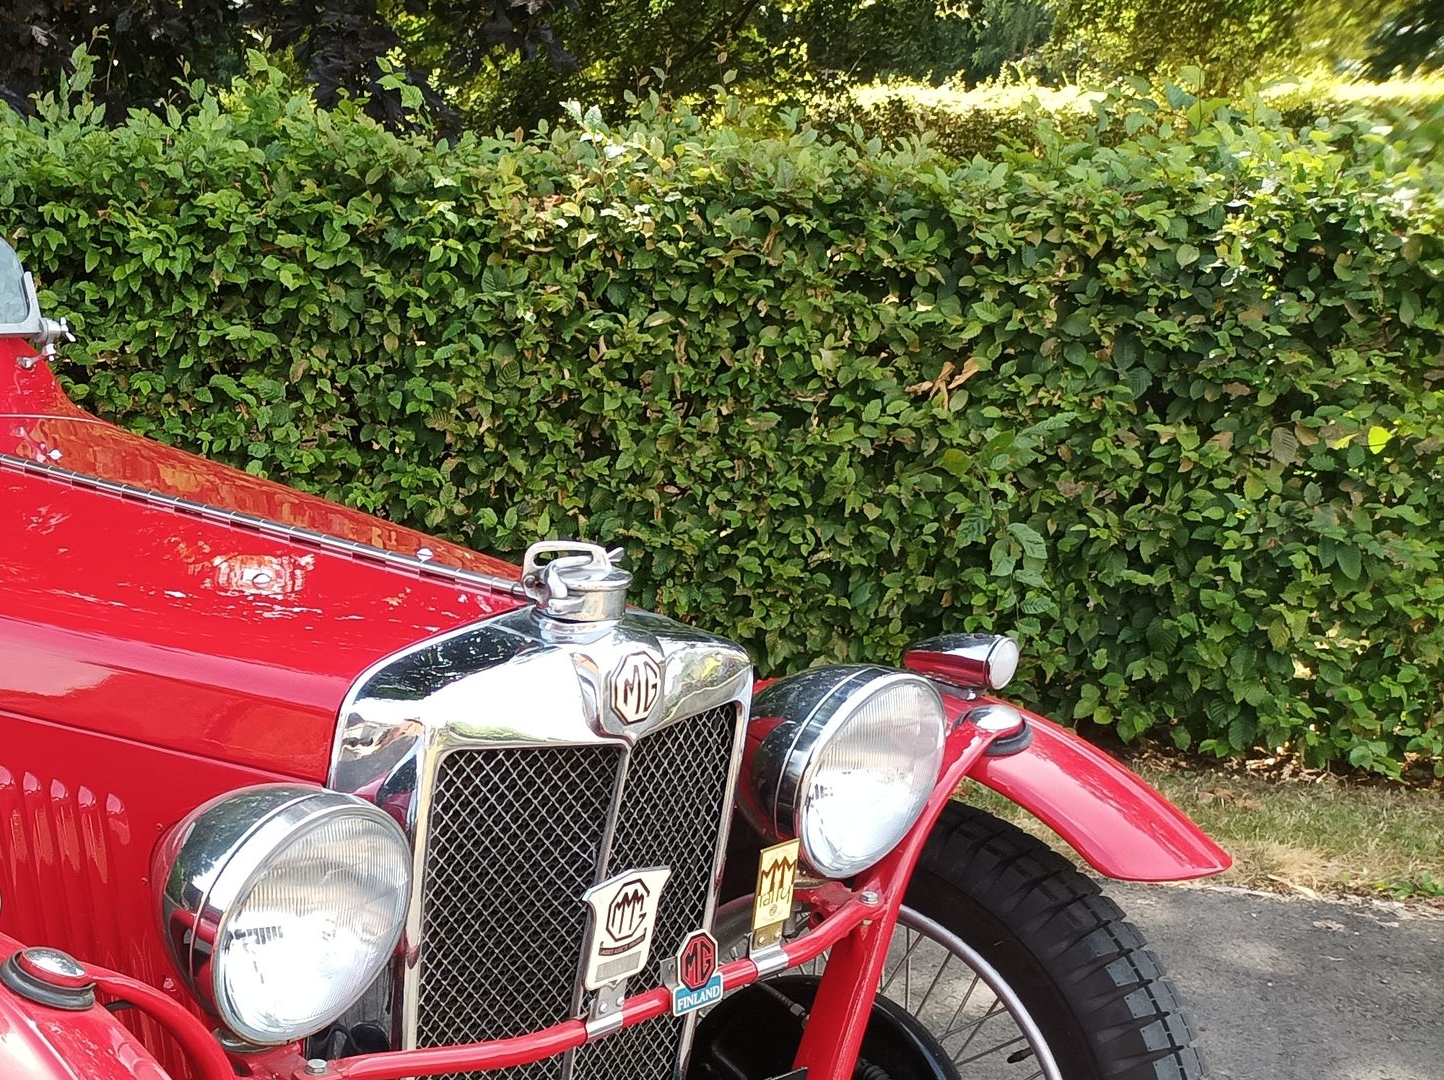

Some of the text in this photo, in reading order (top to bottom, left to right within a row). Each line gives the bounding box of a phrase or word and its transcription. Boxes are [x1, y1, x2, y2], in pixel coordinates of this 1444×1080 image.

[622, 659, 659, 715] MG
[684, 938, 713, 985] MG
[677, 985, 720, 1011] FINLAND
